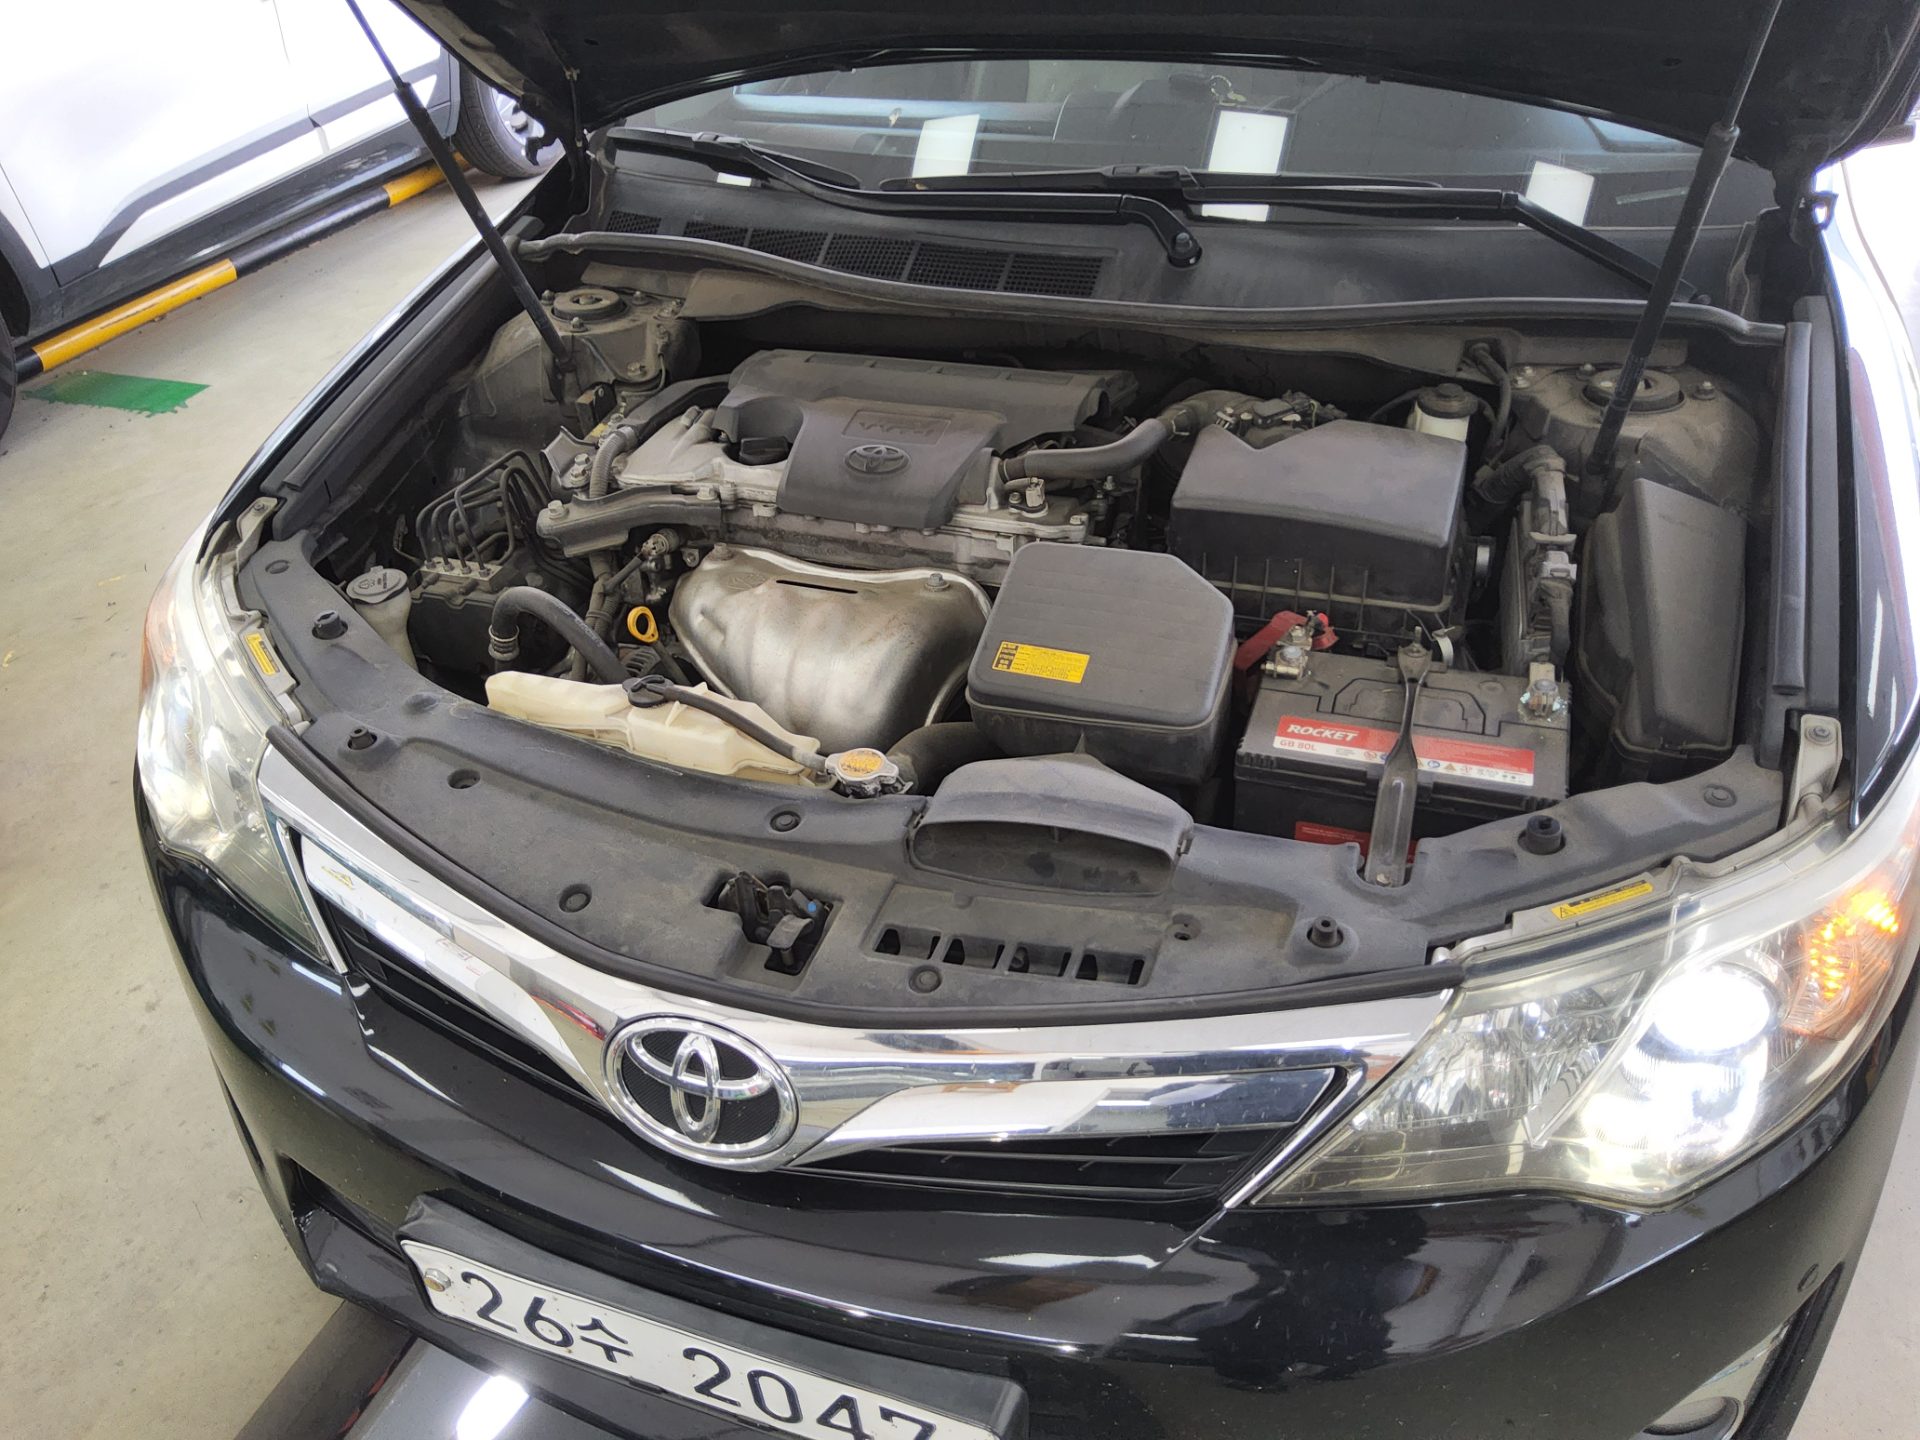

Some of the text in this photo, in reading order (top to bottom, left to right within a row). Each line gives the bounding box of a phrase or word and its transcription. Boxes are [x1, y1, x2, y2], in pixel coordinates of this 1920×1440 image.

[1286, 723, 1359, 742] ROCKET
[460, 1270, 937, 1440] 26수 2047
